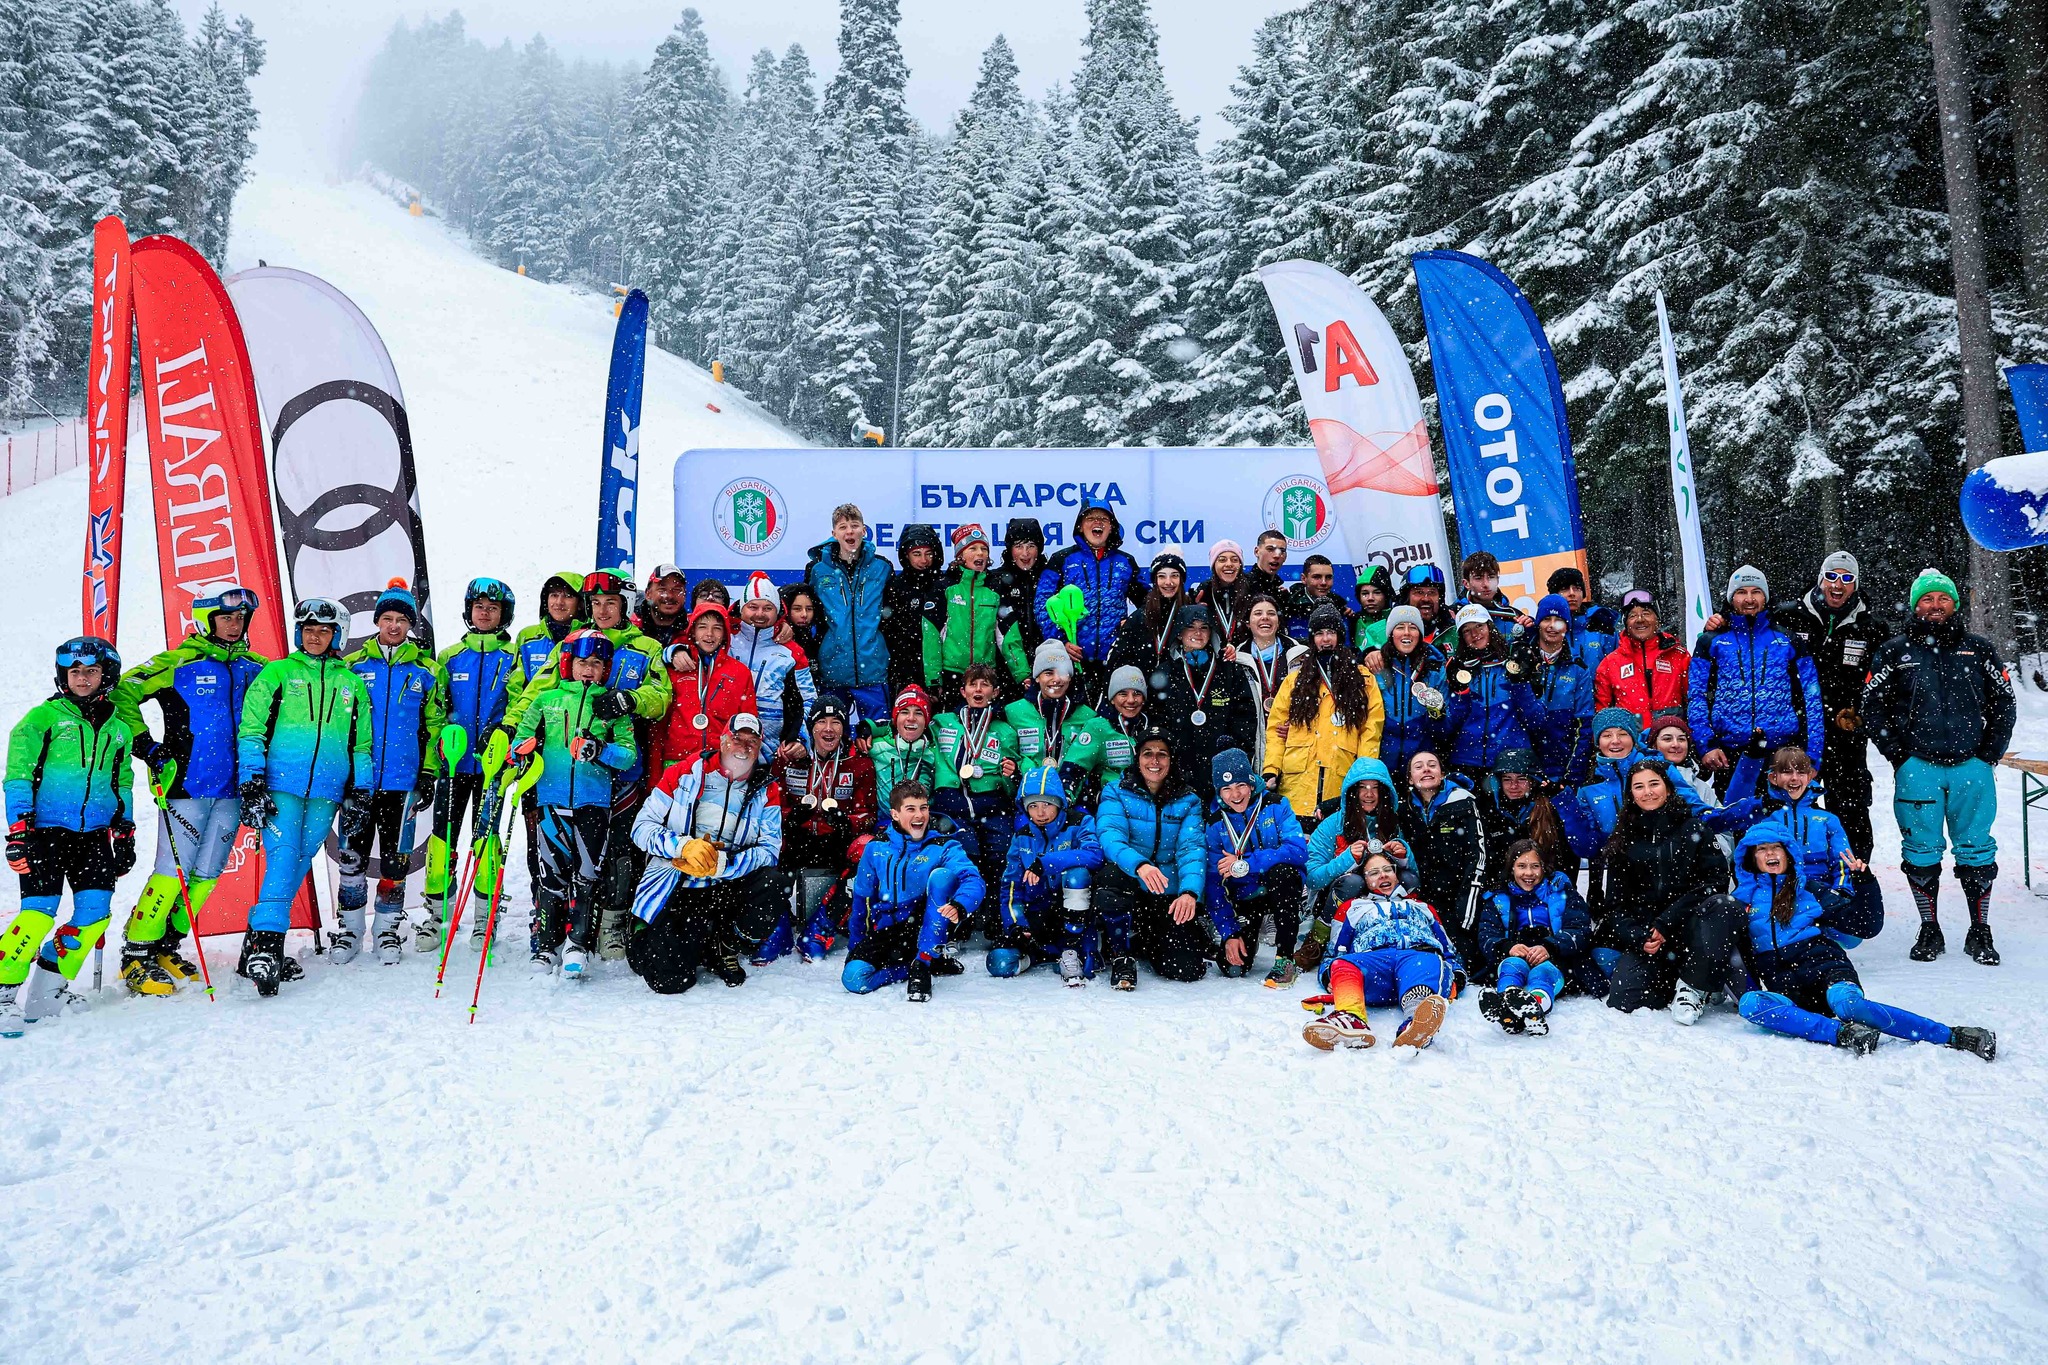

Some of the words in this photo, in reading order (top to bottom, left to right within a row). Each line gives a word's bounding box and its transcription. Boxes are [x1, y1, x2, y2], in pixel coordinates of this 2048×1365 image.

[725, 481, 774, 497] BULGARIAN
[921, 482, 1127, 508] БЪЛГАРСКА
[1275, 478, 1323, 495] BULGARIAN
[719, 525, 732, 541] SKI
[733, 526, 782, 552] FEDERATION
[1135, 520, 1205, 544] СКИ
[1286, 522, 1331, 548] EDERATION
[1622, 665, 1633, 677] A1
[196, 687, 216, 696] One
[840, 773, 852, 785] A1
[149, 893, 165, 919] LEKI
[11, 934, 31, 962] LEKI
